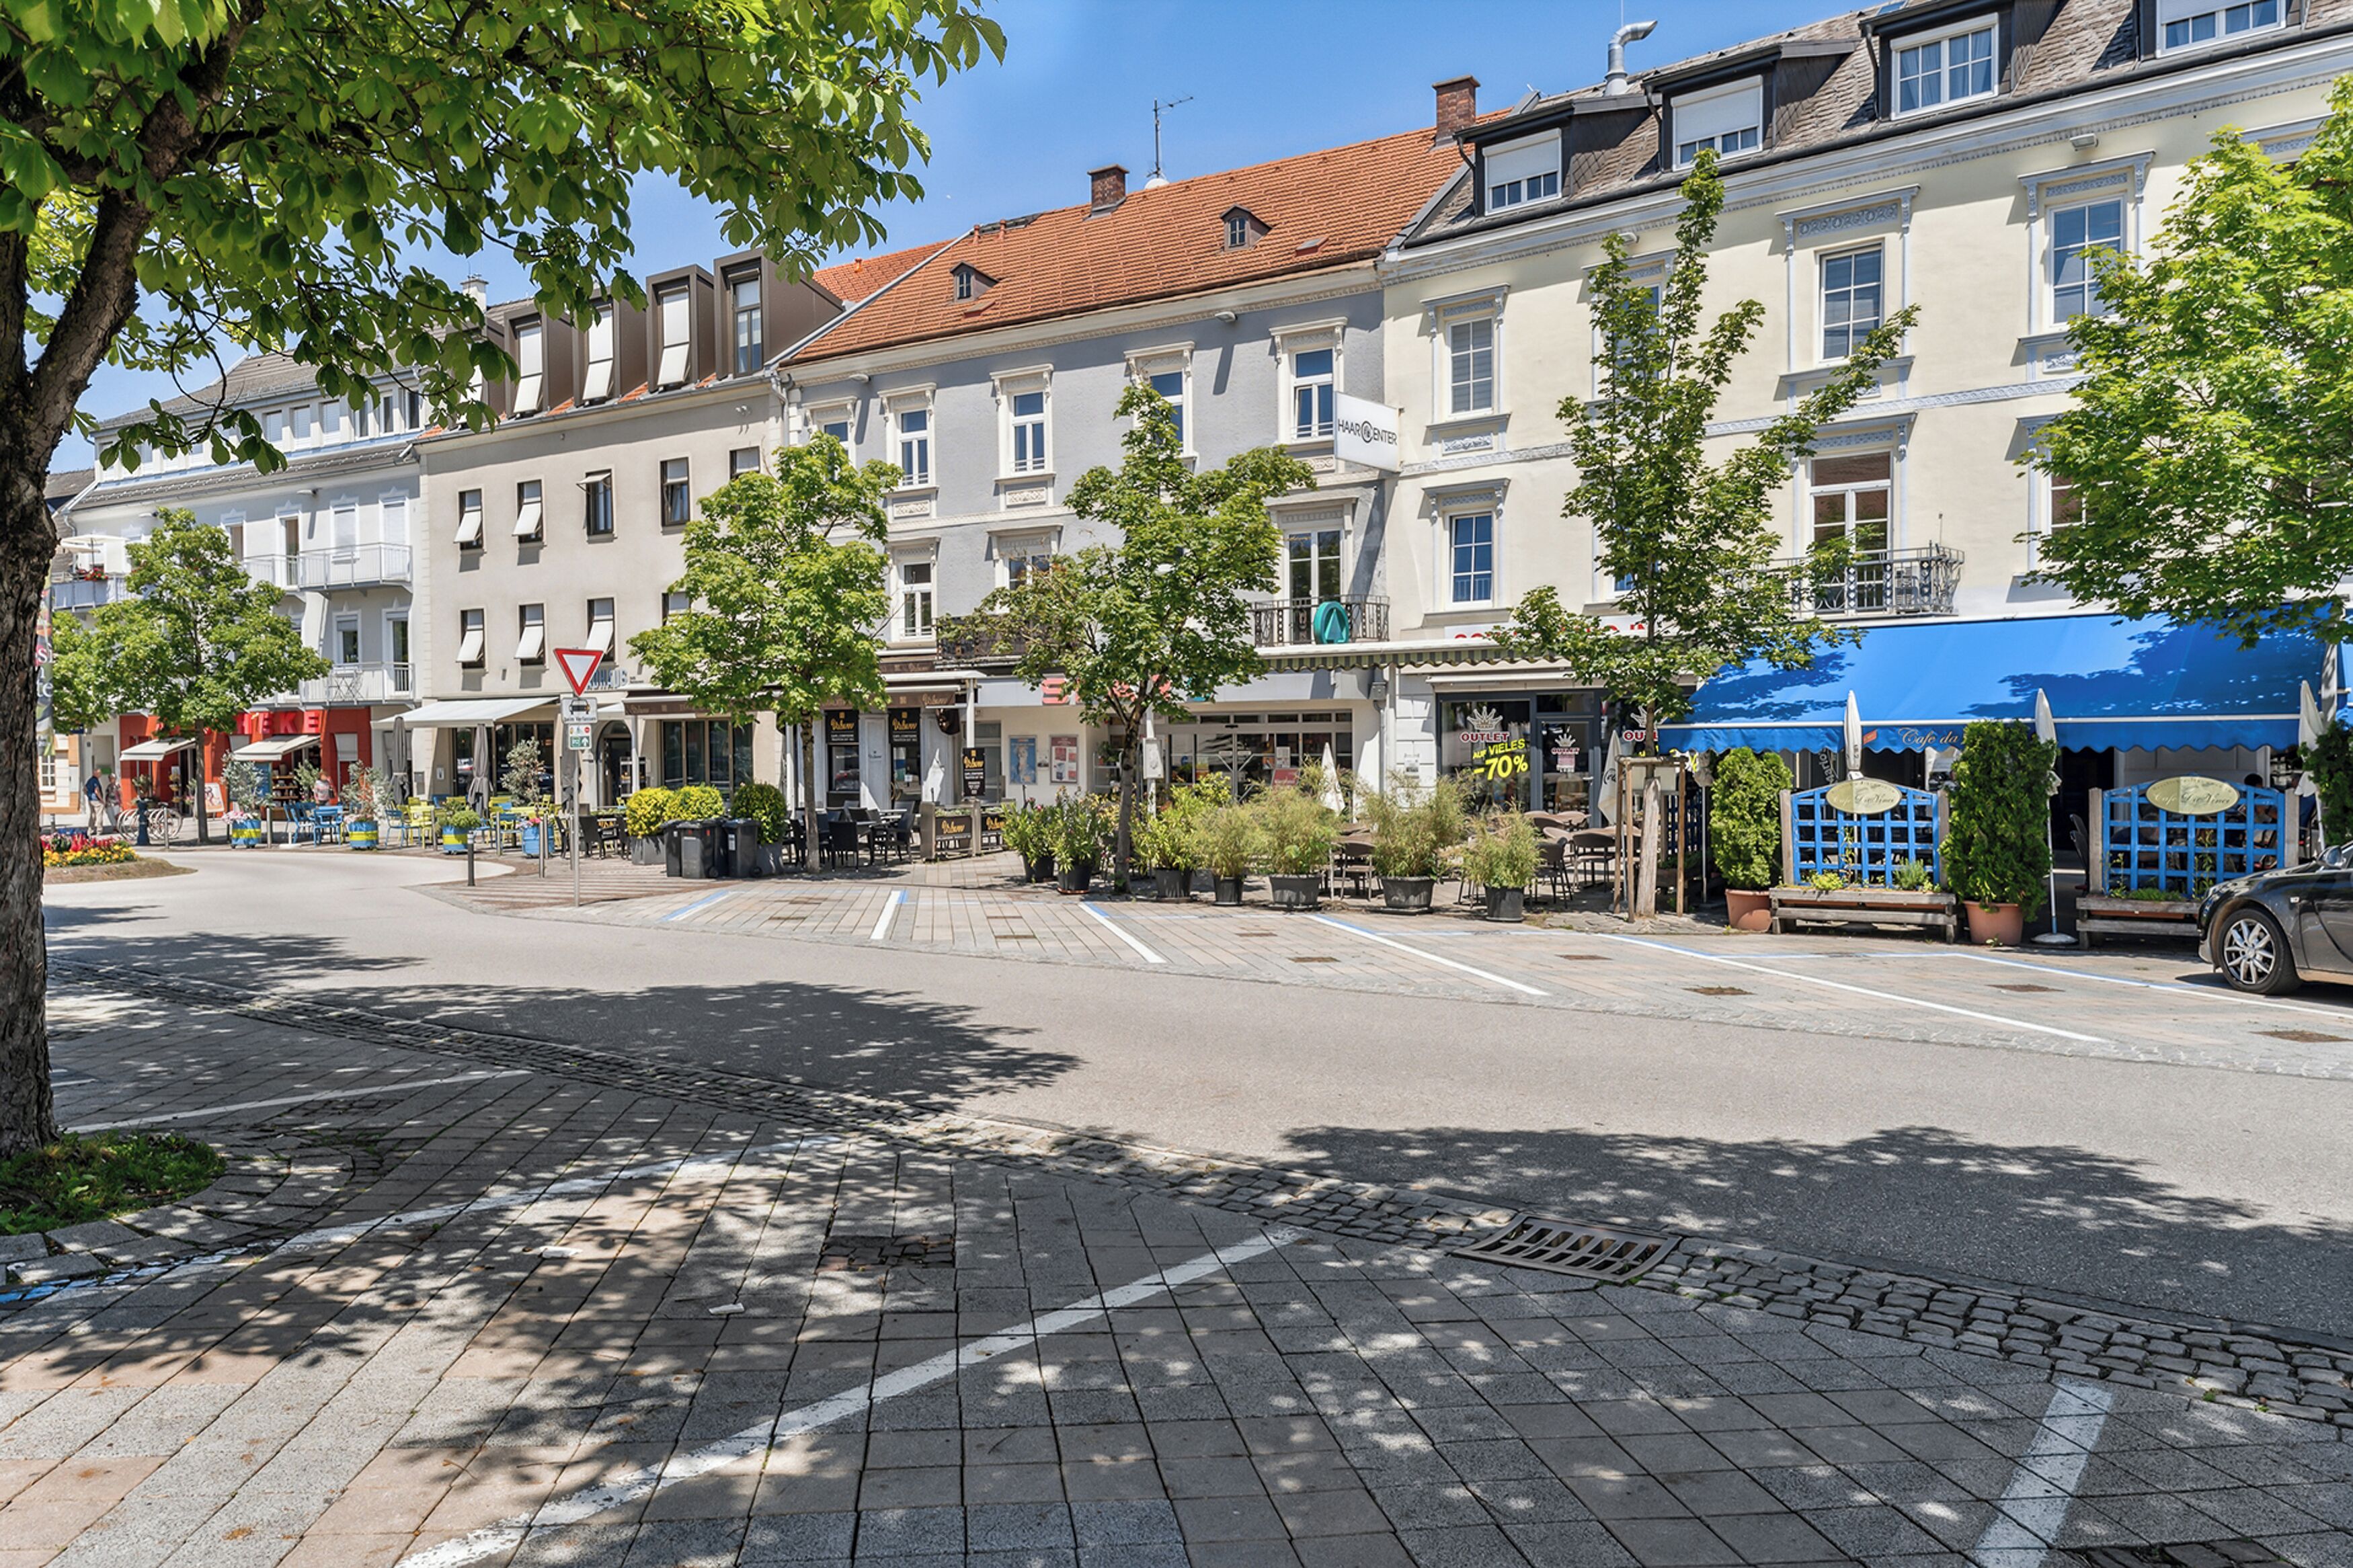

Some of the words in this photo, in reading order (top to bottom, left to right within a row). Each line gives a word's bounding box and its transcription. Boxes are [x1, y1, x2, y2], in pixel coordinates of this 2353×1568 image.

[1461, 732, 1510, 743] OUTLET
[1940, 731, 1958, 744] da
[1488, 738, 1525, 755] VIELES
